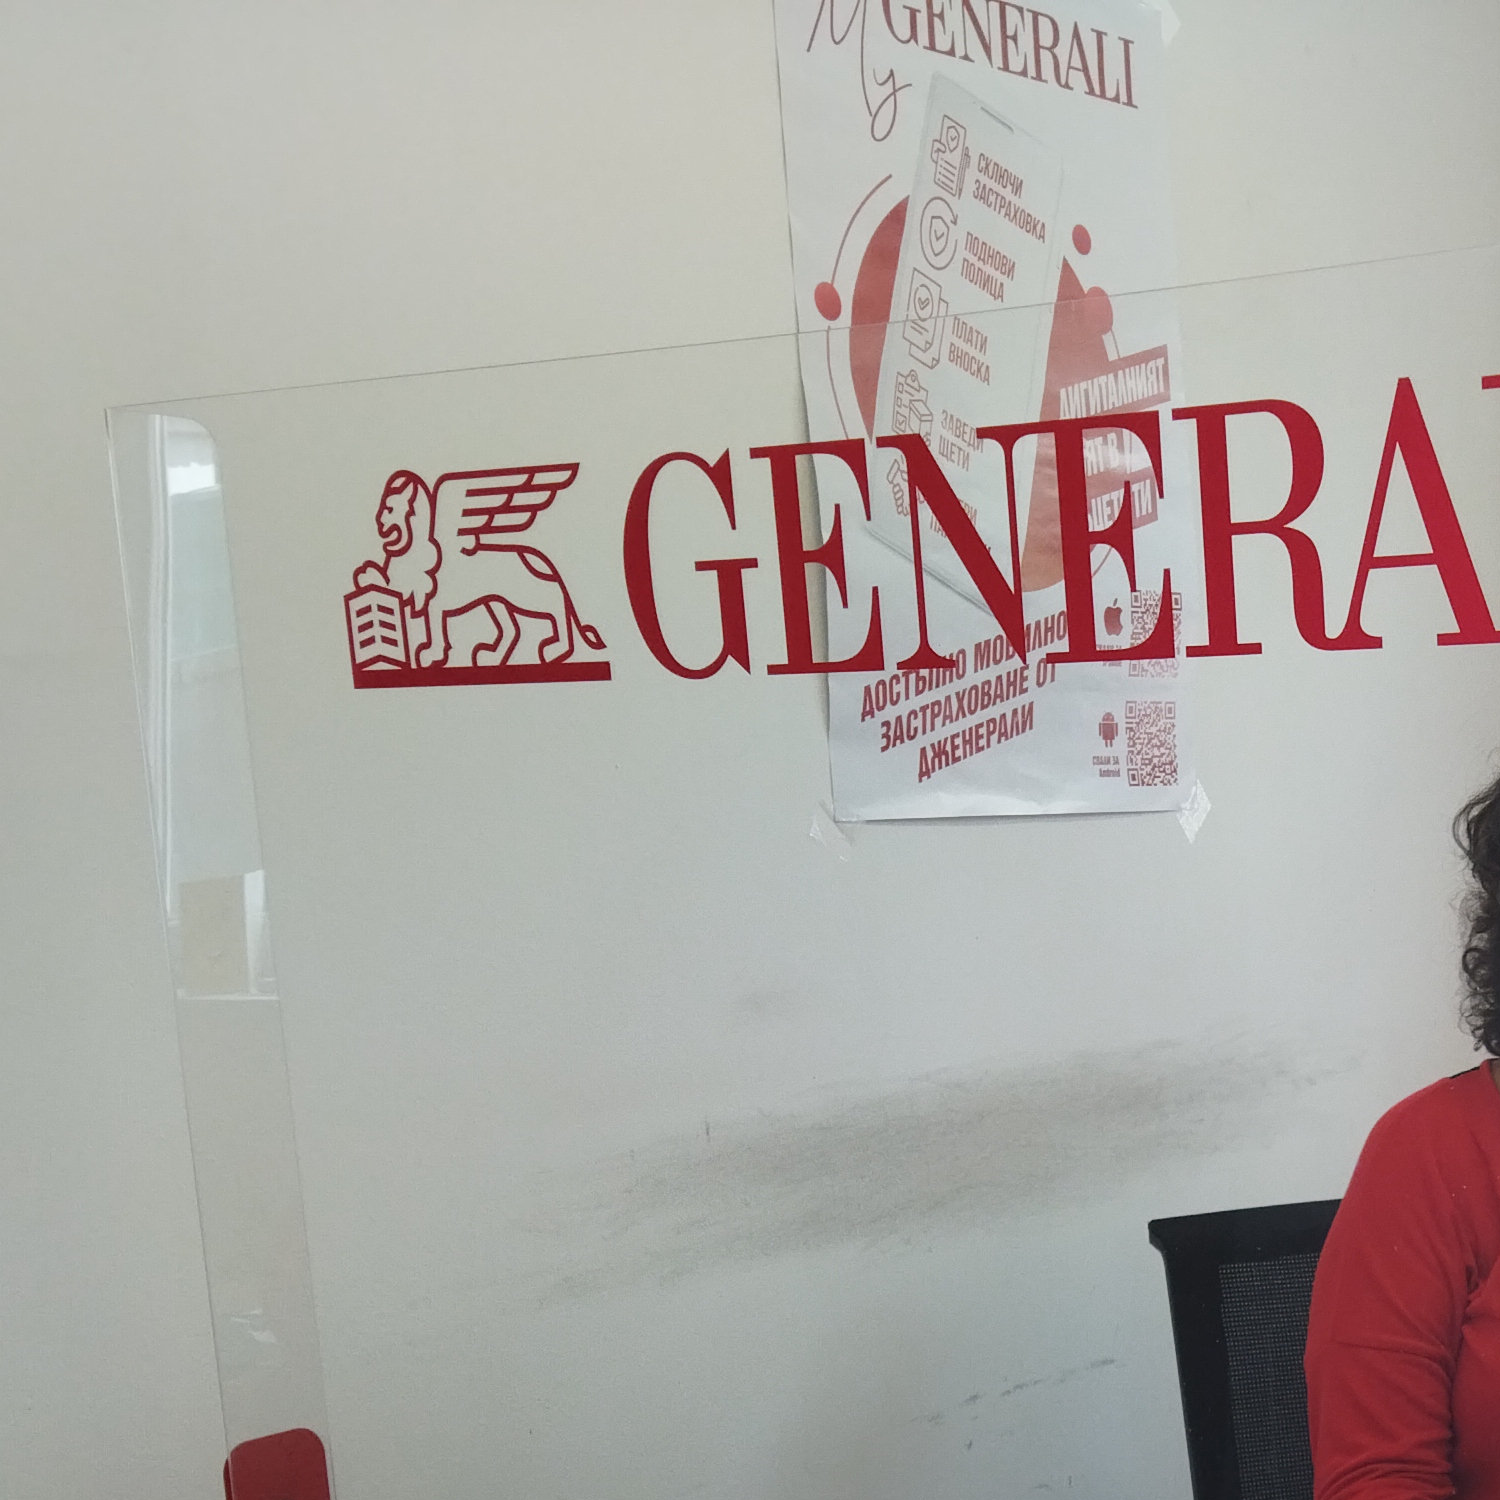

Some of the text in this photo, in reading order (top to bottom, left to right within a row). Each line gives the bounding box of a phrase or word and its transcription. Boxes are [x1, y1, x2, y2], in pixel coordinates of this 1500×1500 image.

[880, 0, 1138, 108] GENERALI
[977, 152, 1023, 199] СКЛЮЧИ
[973, 178, 1045, 244] ЗАСТРАХОВКА
[960, 257, 1004, 302] ПОЛИЦА
[964, 231, 1016, 281] ПОДНОВИ
[952, 315, 988, 356] ПЛАТИ
[948, 342, 990, 386] ВНОСКА
[938, 434, 970, 472] ЩЕТИ
[880, 664, 1030, 753] ЗАСТРАХОВАНЕ
[918, 701, 1034, 783] ДЖЕНЕРАЛИ
